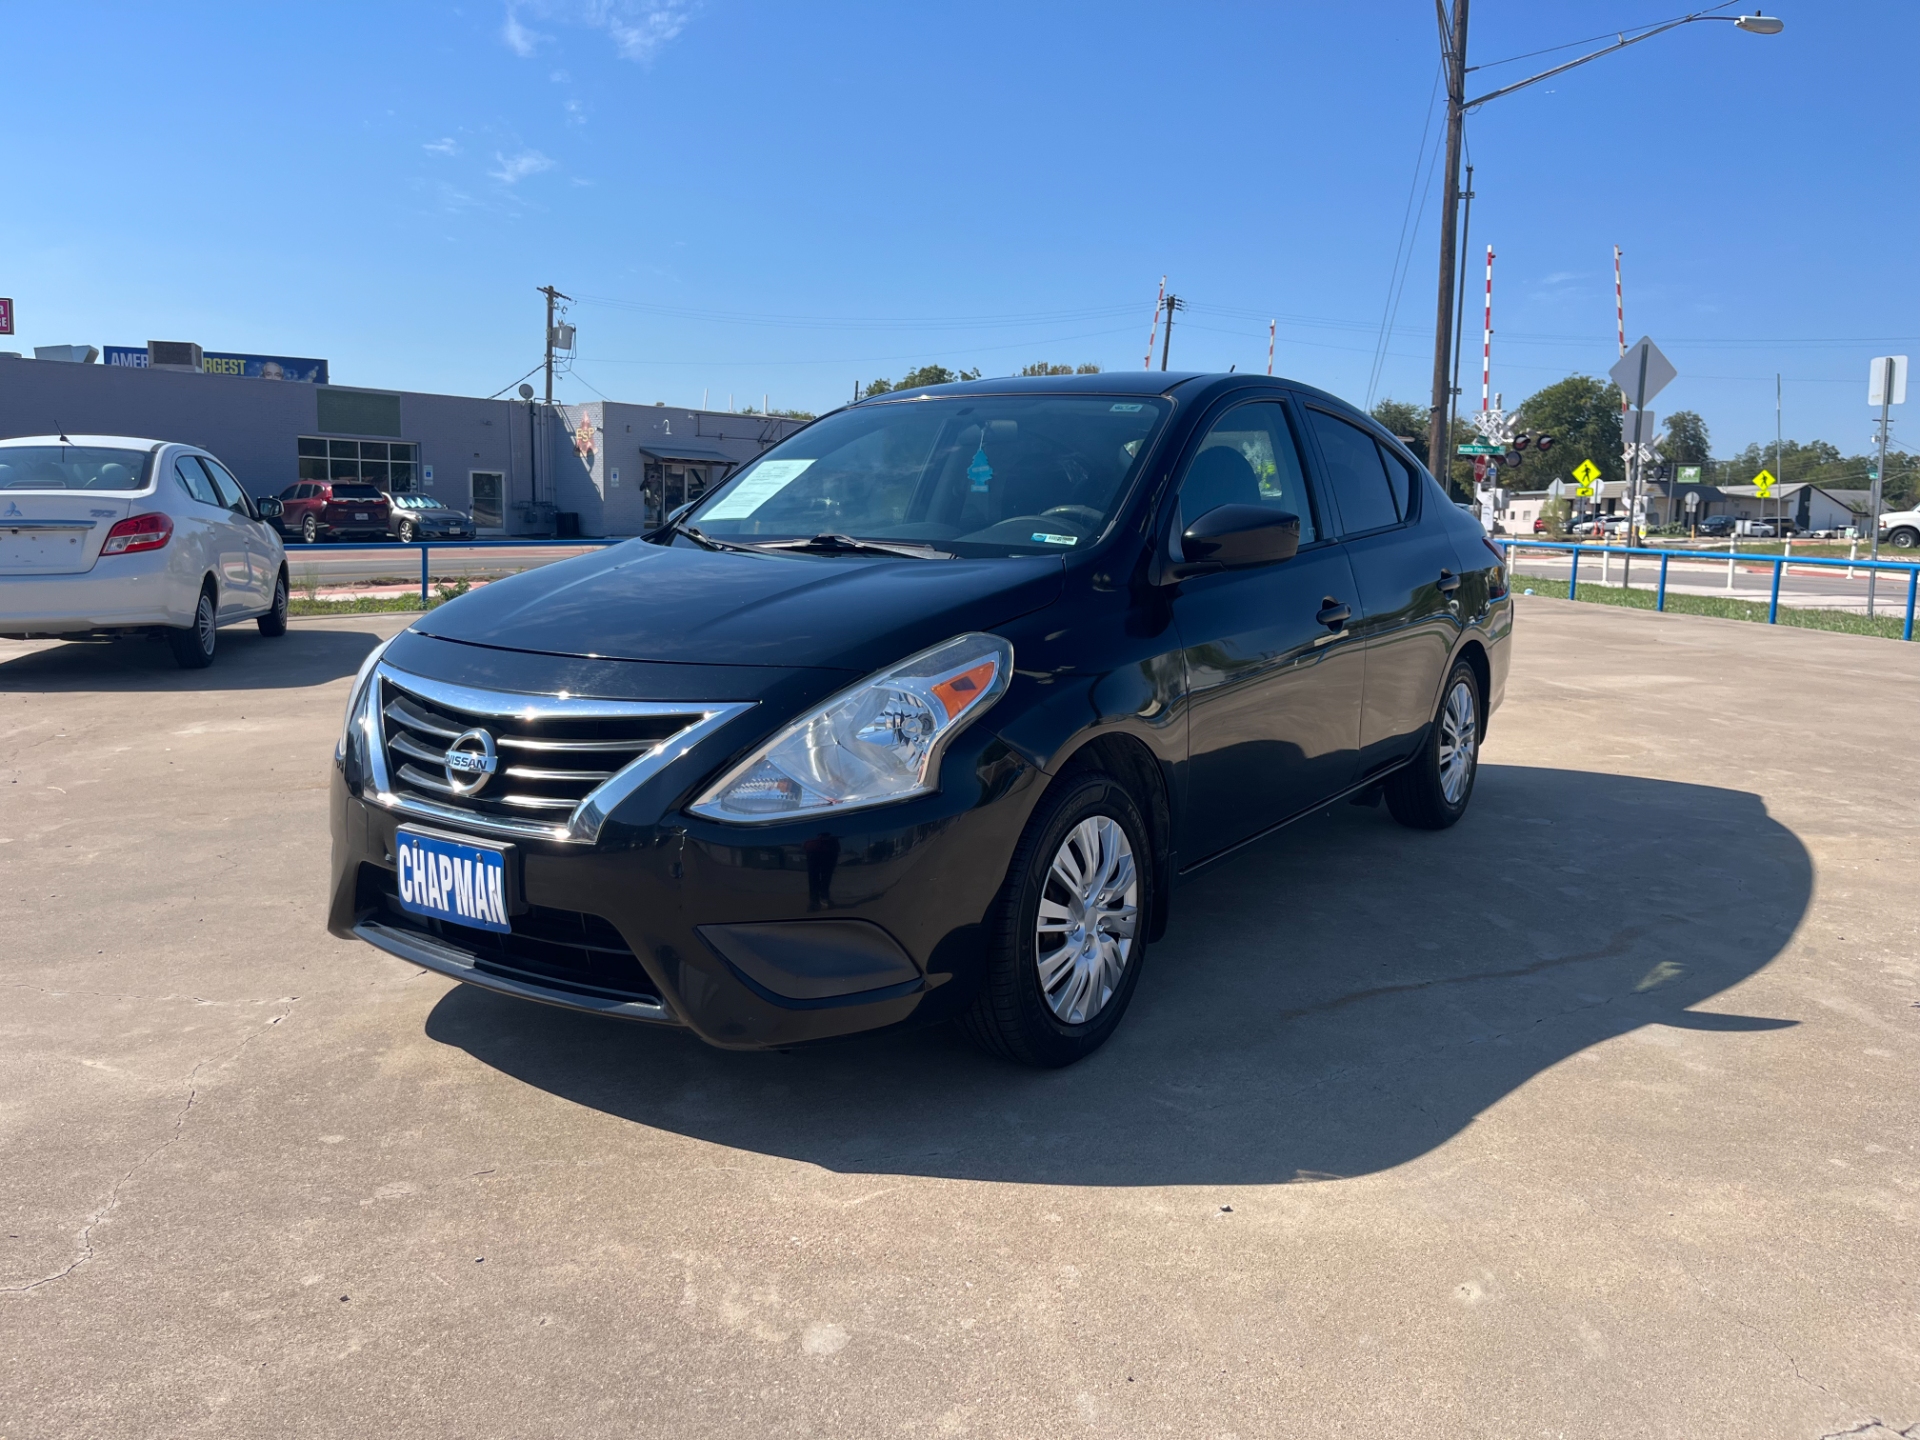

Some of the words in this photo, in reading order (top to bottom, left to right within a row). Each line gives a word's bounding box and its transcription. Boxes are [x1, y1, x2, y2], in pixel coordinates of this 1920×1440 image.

[111, 352, 149, 368] AMER
[203, 357, 246, 375] RGEST
[576, 427, 595, 442] ESP
[446, 754, 488, 770] NISSAN
[399, 844, 508, 926] CHAPMAN
